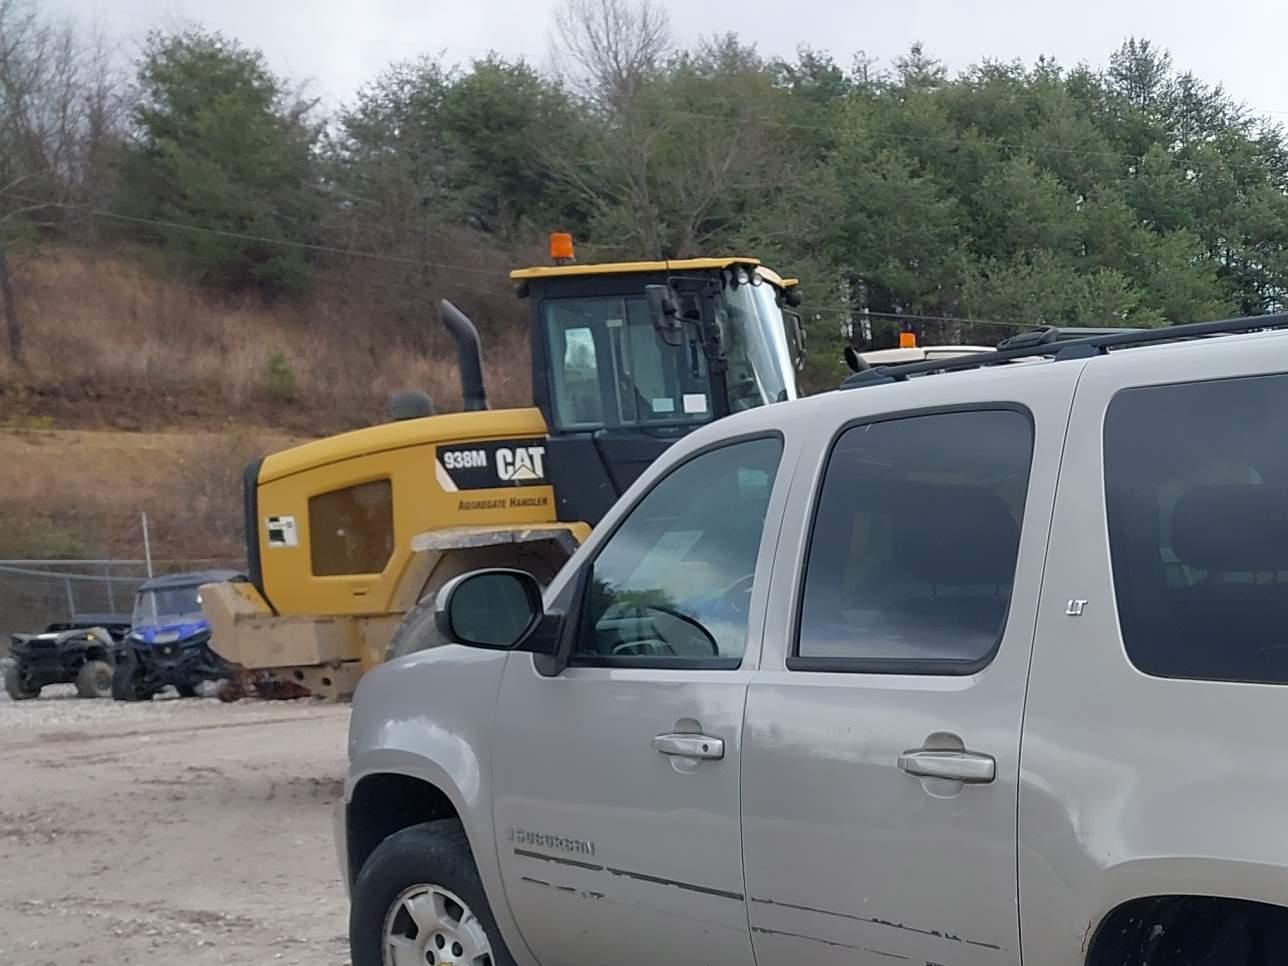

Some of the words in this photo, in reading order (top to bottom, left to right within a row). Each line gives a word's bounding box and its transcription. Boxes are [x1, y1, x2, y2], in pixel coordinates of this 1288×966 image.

[443, 450, 487, 469] 938M
[495, 446, 545, 481] CAT
[1065, 599, 1089, 617] LT
